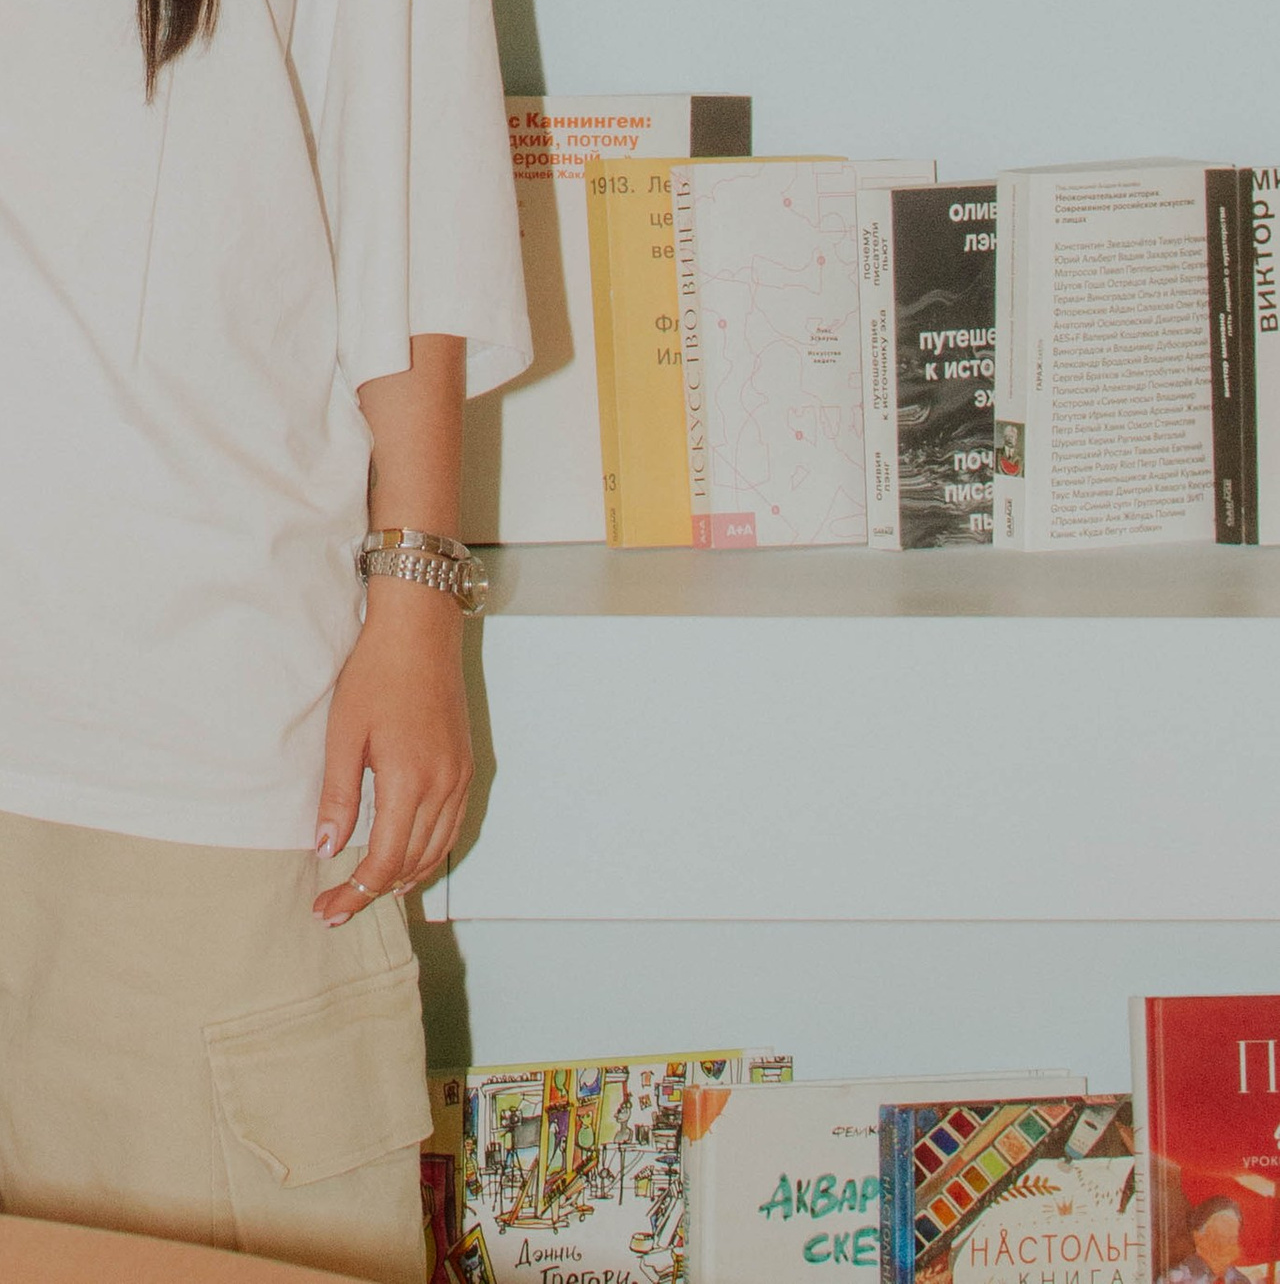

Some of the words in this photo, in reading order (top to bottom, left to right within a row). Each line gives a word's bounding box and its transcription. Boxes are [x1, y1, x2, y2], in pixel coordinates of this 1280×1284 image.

[525, 112, 652, 130] Каннингем:
[567, 134, 639, 151] потому
[590, 175, 635, 196] 1913.
[1055, 191, 1127, 202] Неокончательная
[1128, 190, 1160, 199] история
[1054, 203, 1111, 214] Современное
[1112, 199, 1158, 212] российское
[675, 181, 697, 297] ВИДЕТЬ
[863, 227, 872, 281] почему
[871, 221, 880, 287] писатели
[881, 237, 889, 271] пьют
[879, 309, 887, 334] эха
[1219, 312, 1227, 351] мизиано
[870, 318, 880, 410] путешествие
[880, 337, 889, 408] источнику
[924, 363, 939, 381] к
[1222, 354, 1231, 399] виктор
[689, 307, 707, 498] ИСКУССТВО
[874, 451, 883, 502] оливия
[883, 461, 891, 492] лэнг
[1005, 497, 1013, 537] GARAGE
[1224, 479, 1234, 528] GARAGE
